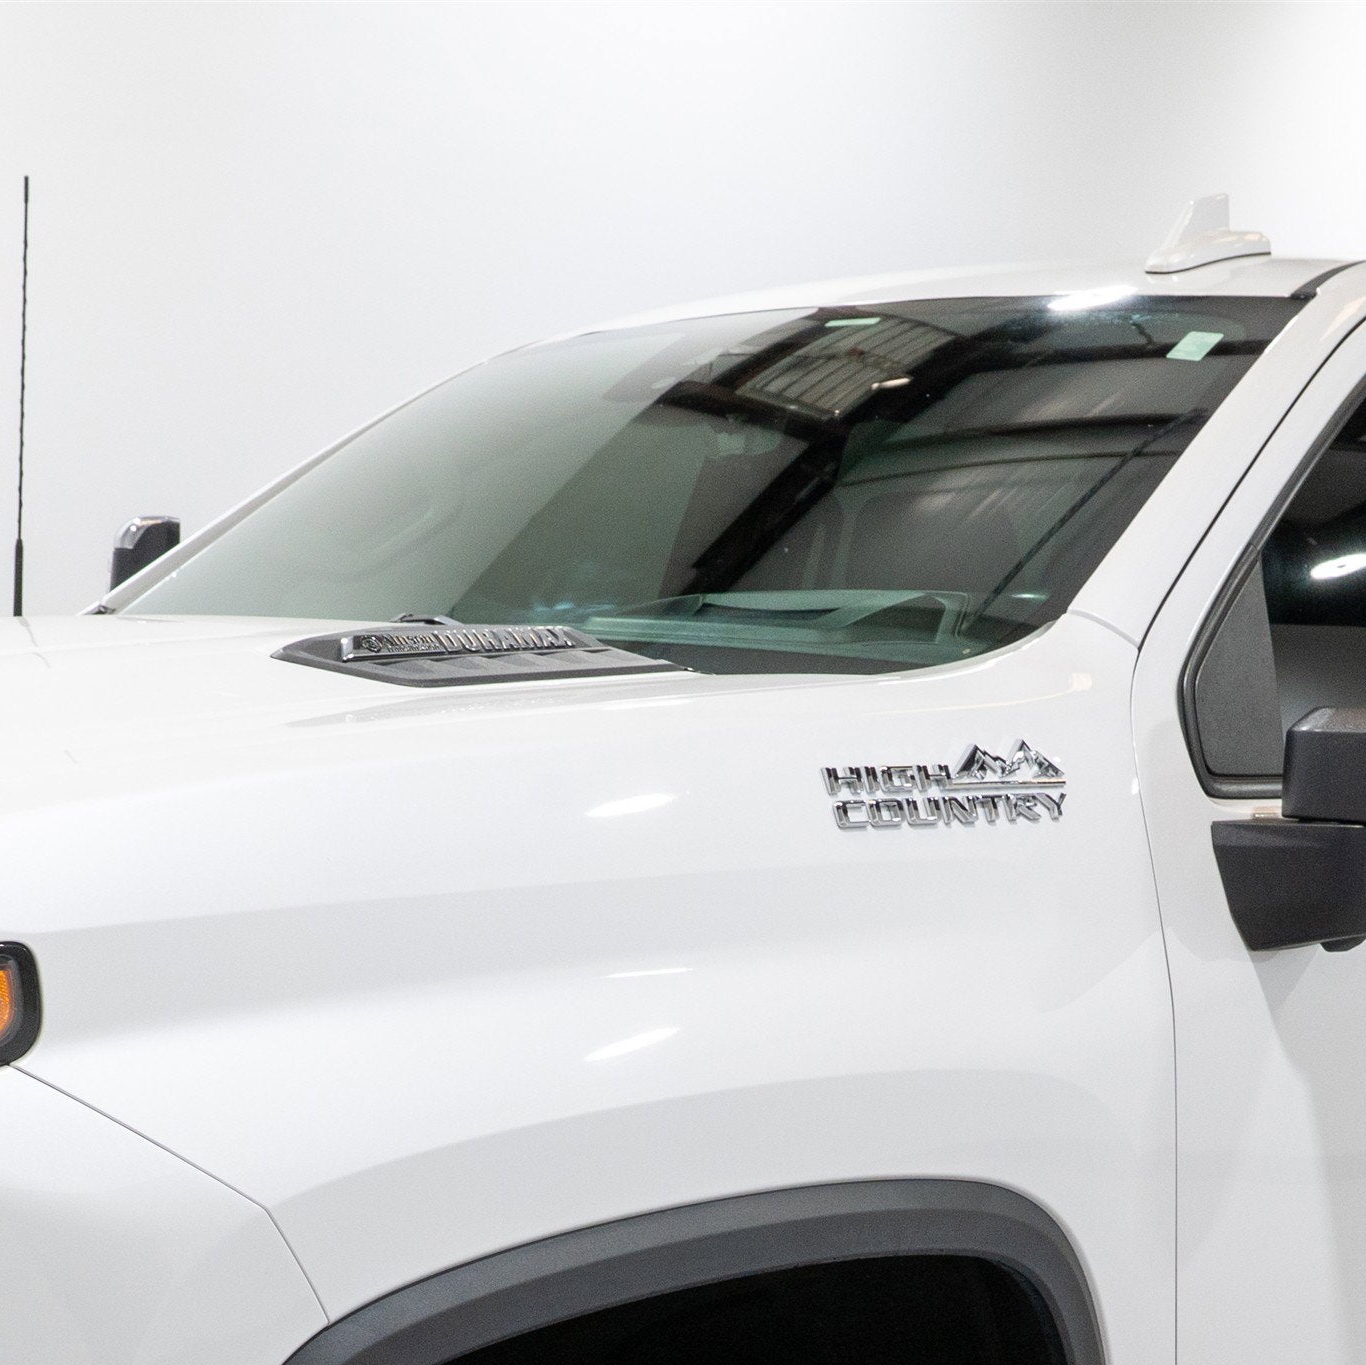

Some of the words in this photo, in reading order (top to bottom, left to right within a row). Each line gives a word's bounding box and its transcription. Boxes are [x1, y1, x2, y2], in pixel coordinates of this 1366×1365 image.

[432, 626, 575, 653] DURAMAX
[820, 763, 953, 796] HIGH
[832, 791, 1067, 828] COUNTRY
